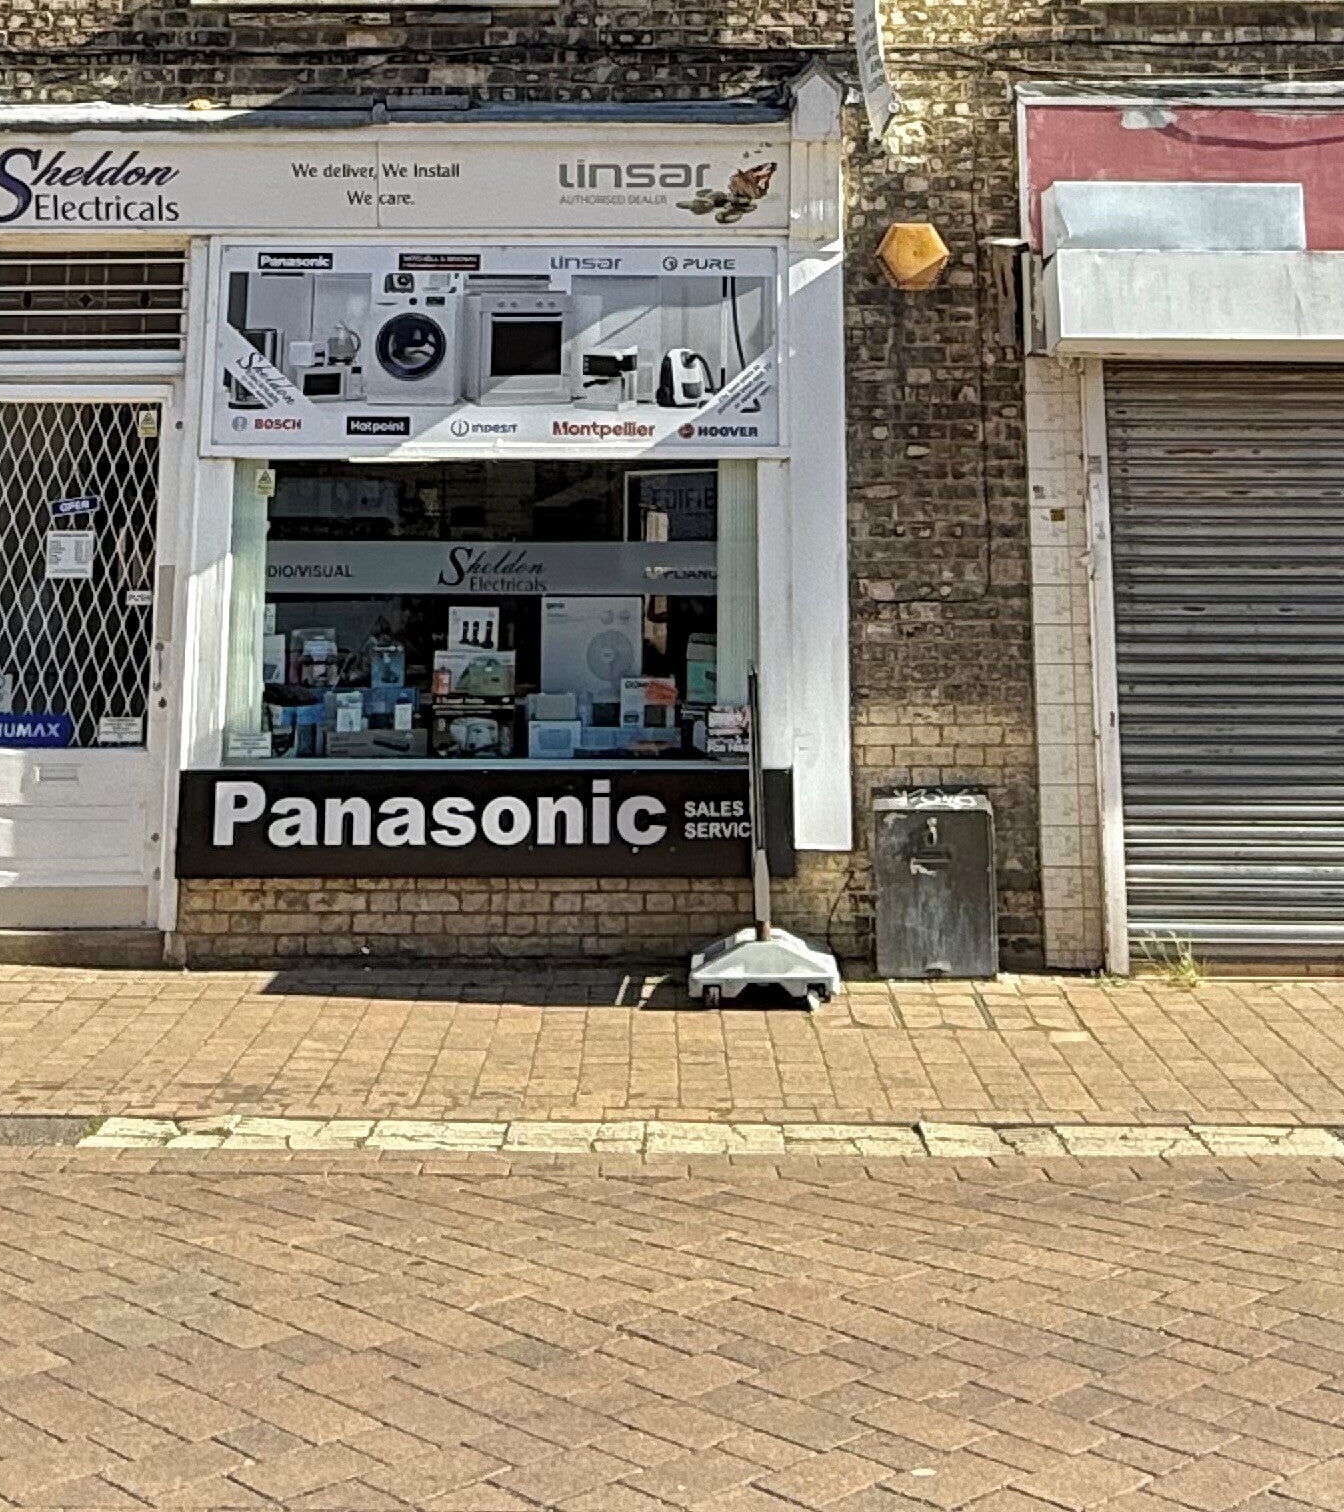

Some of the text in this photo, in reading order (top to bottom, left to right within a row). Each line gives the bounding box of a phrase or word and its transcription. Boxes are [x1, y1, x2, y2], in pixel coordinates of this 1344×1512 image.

[291, 162, 460, 180] We deliver, We Install
[347, 190, 415, 205] We care.
[628, 194, 667, 205] DEALER
[35, 194, 179, 221] Electricals
[260, 255, 330, 268] Panasonic
[683, 258, 736, 270] PURE
[254, 418, 302, 430] BOSCH
[350, 420, 405, 433] Hotpoint
[552, 421, 655, 439] Montpellier
[698, 426, 758, 437] HOOVER
[267, 565, 354, 578] DIO/VISUAL
[437, 547, 545, 586] Sheldon
[469, 577, 547, 592] Electricals
[213, 779, 668, 847] Panasonic
[684, 801, 744, 818] SALES
[684, 822, 752, 839] SERVIC
